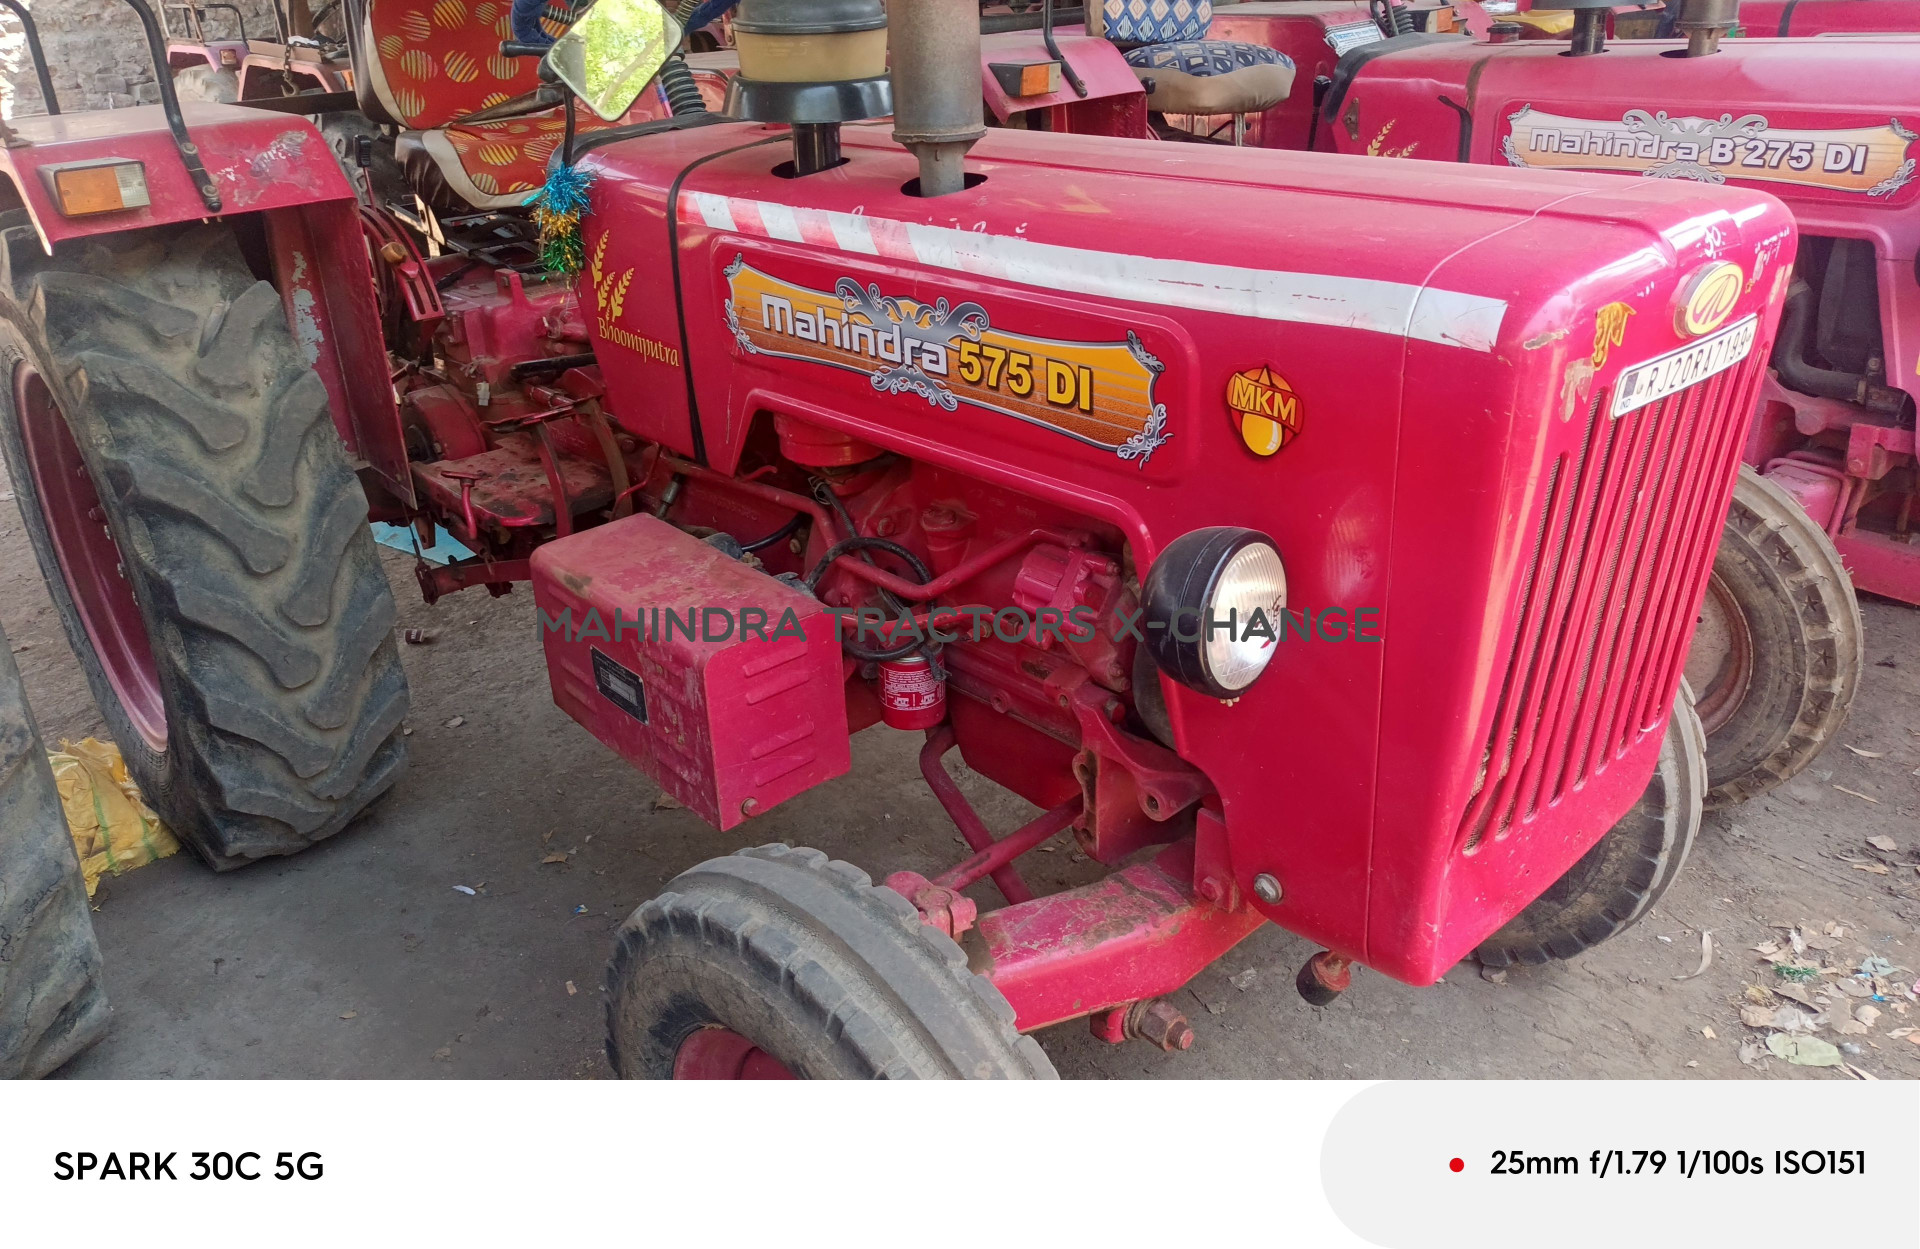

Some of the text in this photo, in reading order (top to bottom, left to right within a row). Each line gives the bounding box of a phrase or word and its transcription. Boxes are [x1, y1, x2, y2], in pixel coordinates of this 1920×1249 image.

[1529, 127, 1869, 173] Mahindra B 275 DI
[597, 316, 679, 367] Bhoomiputra
[759, 293, 1093, 413] Mahindra 575 DI
[1645, 326, 1749, 398] RJ20RA7199
[1231, 375, 1297, 427] MKM
